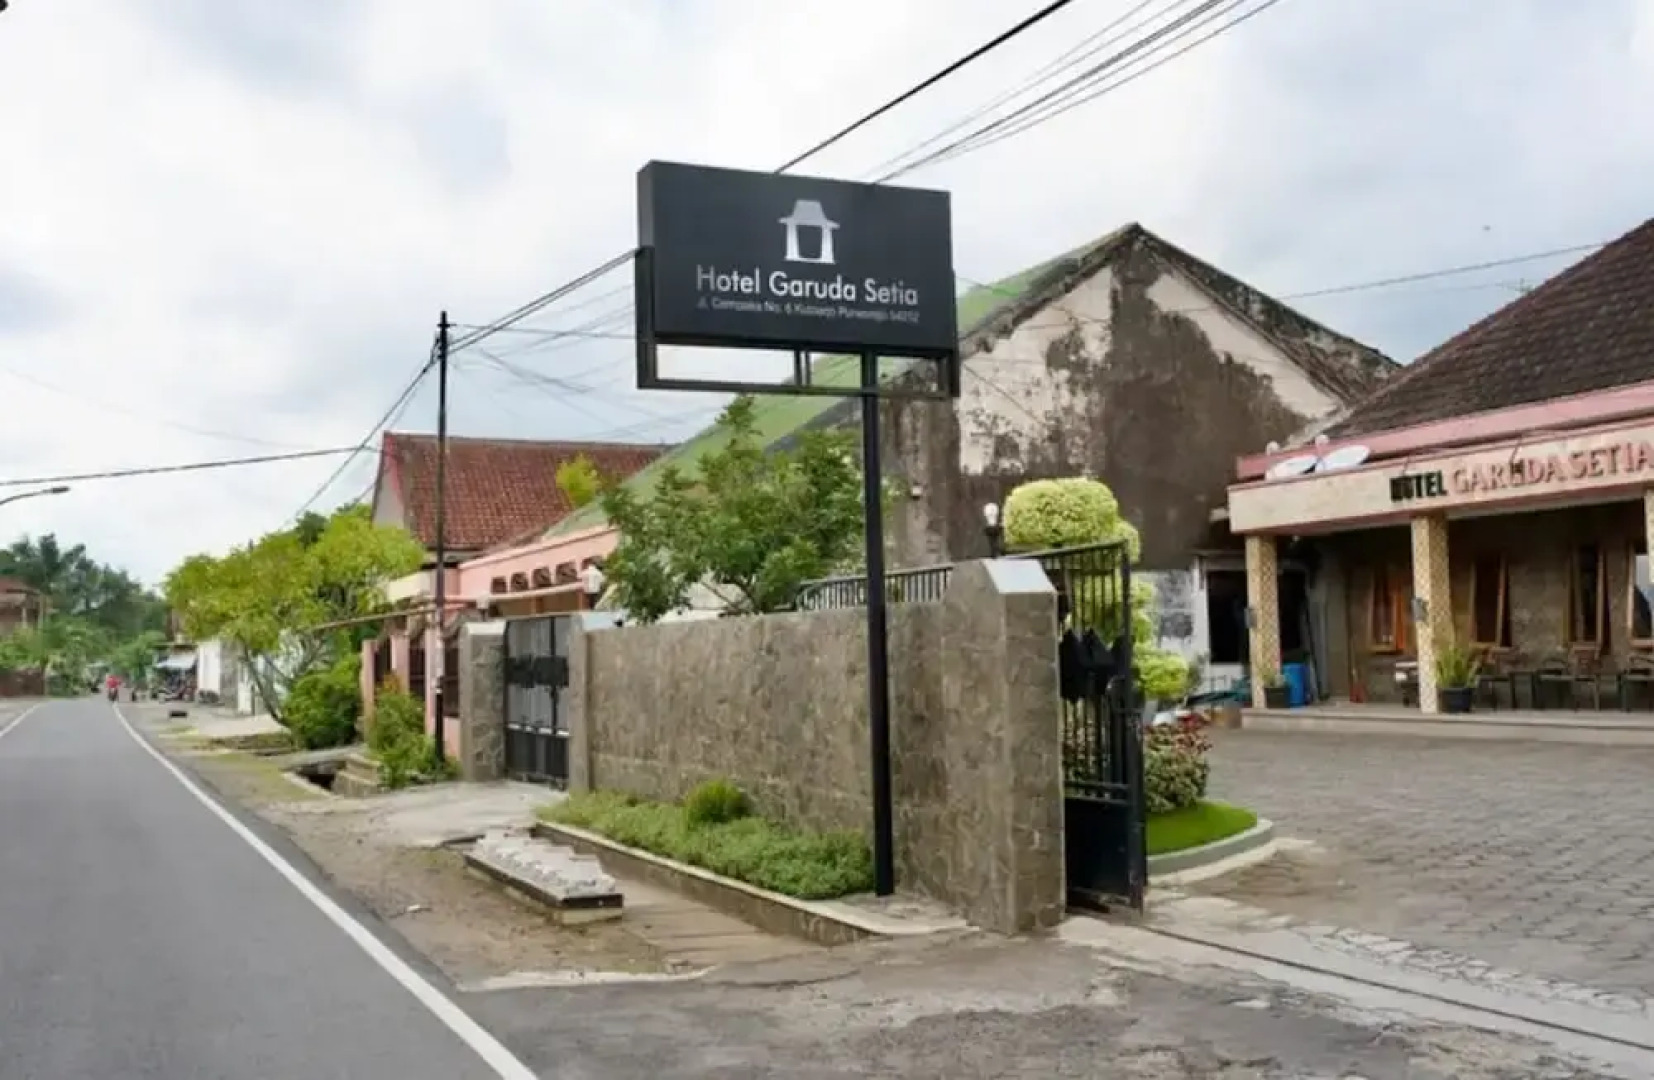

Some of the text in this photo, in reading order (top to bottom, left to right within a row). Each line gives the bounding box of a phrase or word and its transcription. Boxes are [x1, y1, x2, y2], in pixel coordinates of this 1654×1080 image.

[696, 264, 918, 306] Hotel Garuda Setia
[1389, 470, 1447, 503] TEL
[1568, 441, 1654, 480] SETIA
